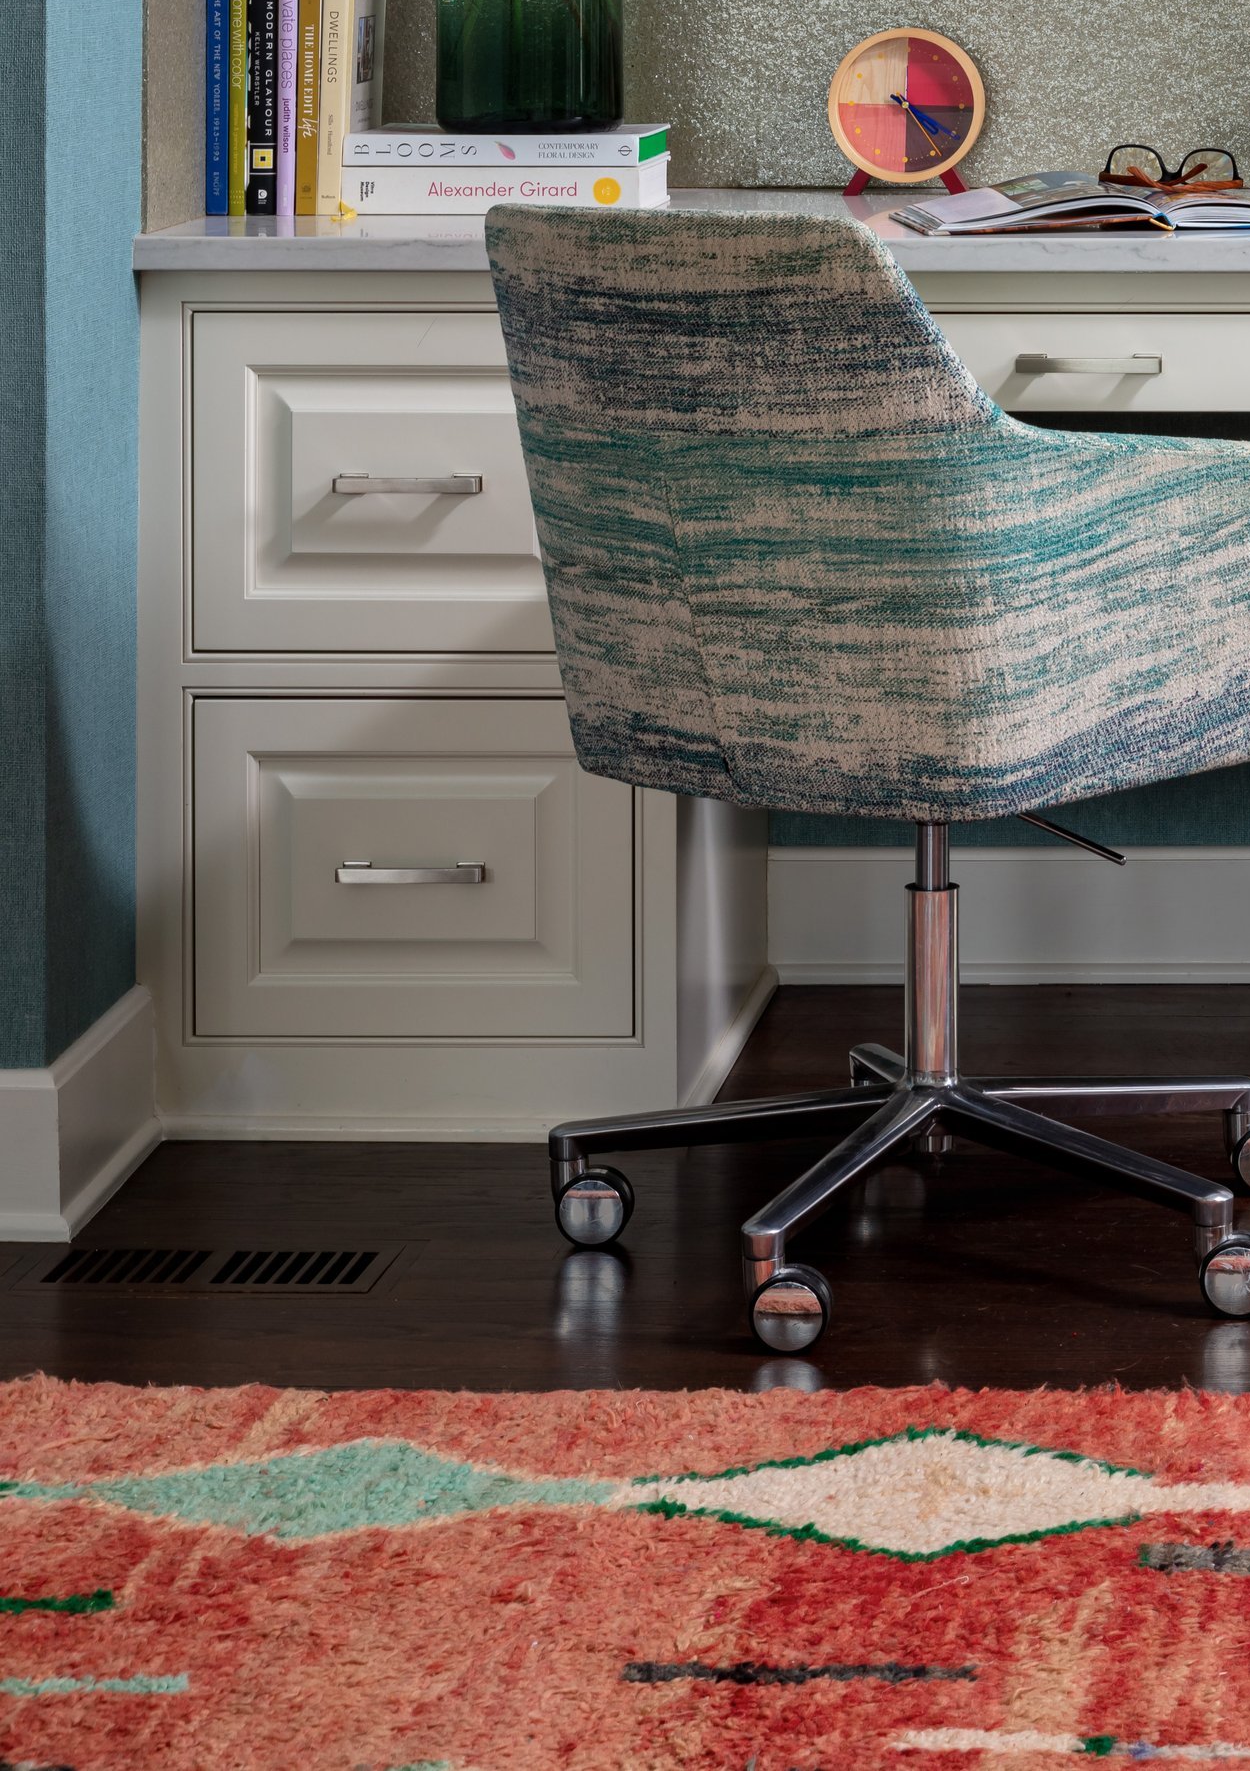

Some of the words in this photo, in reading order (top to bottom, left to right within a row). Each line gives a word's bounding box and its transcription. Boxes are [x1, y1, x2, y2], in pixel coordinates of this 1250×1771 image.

[213, 11, 221, 27] ART
[265, 1, 274, 61] MODERN
[213, 30, 221, 41] OF
[231, 29, 244, 57] with
[304, 24, 314, 49] THE
[327, 11, 339, 84] DWELLINGS
[213, 44, 221, 61] THE
[280, 38, 296, 89] places
[213, 63, 221, 80] NEW
[231, 57, 244, 90] color
[303, 51, 314, 85] HOME
[264, 69, 273, 137] GLAMOUR
[282, 97, 291, 123] judith
[303, 87, 313, 116] EDIT
[282, 125, 291, 154] wilson
[354, 142, 478, 159] BLOOMS
[538, 142, 600, 150] CONTEMPORARY
[538, 151, 567, 159] FLORAL
[568, 151, 595, 159] DESIGN
[428, 181, 515, 197] Alexander
[520, 181, 578, 197] Girard
